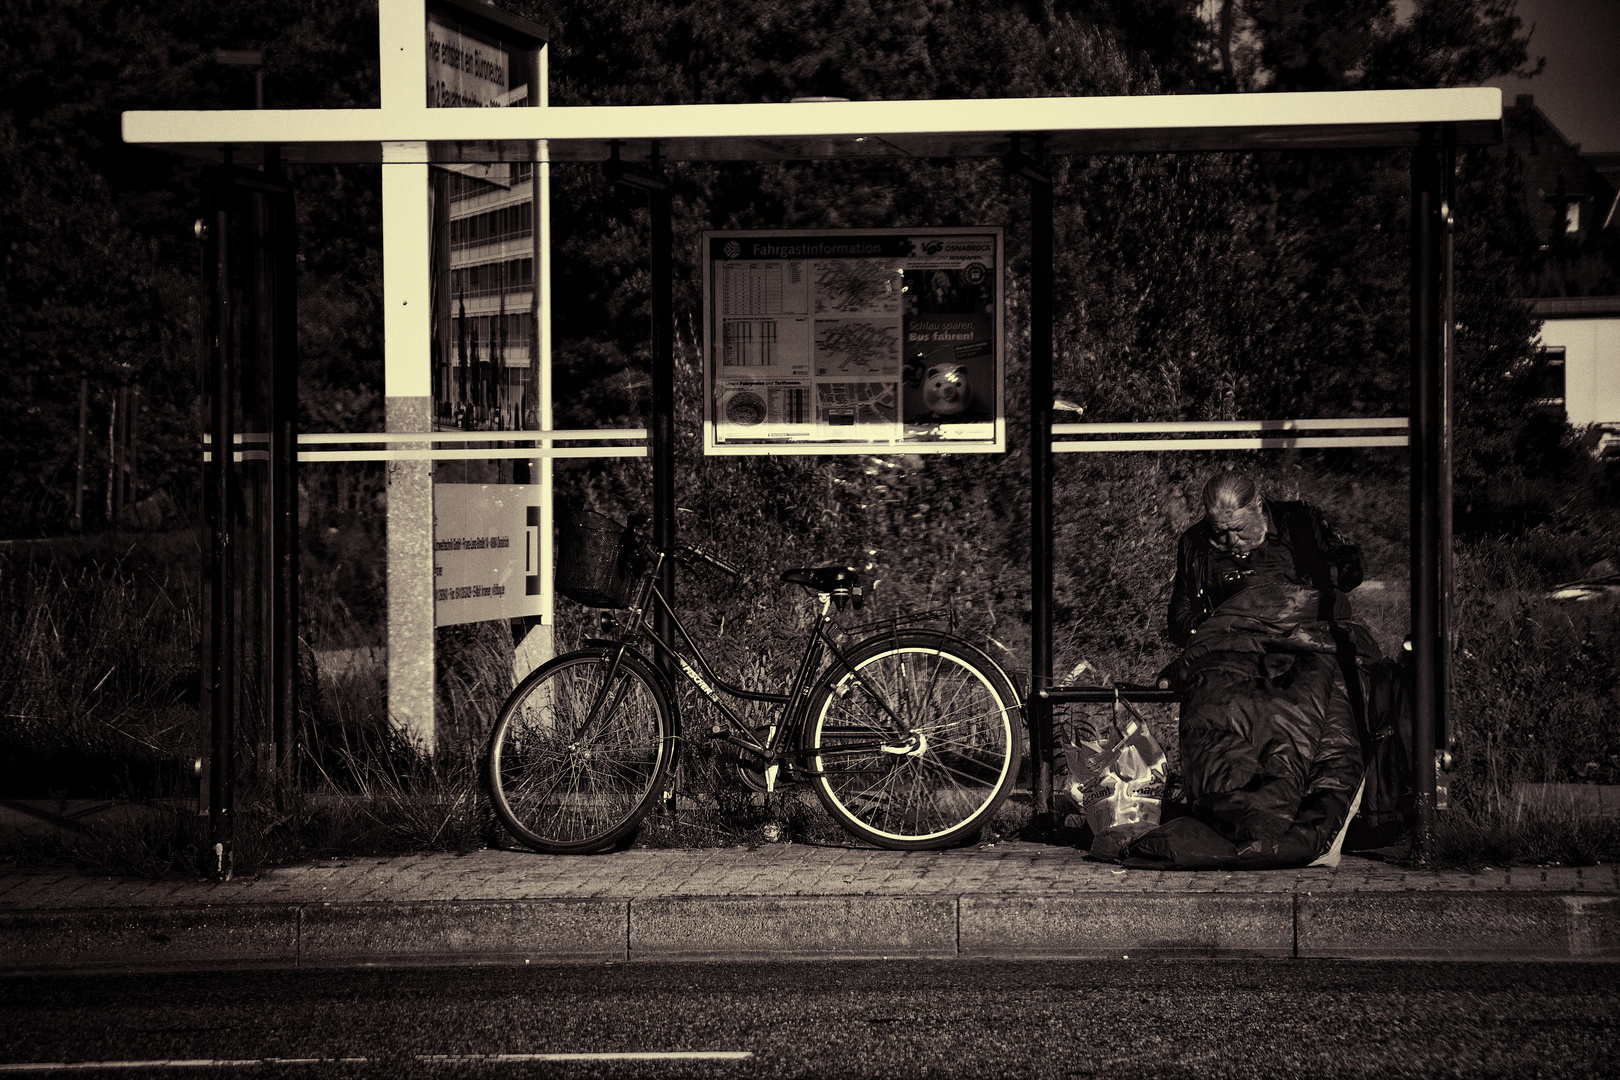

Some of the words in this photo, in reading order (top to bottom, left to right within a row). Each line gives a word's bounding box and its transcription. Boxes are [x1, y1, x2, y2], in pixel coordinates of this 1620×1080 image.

[753, 242, 882, 259] Fahrgastinformation
[945, 244, 992, 252] OSNABRÜCK
[909, 320, 940, 331] Schlau
[942, 321, 976, 332] sparen,
[908, 332, 930, 341] Bus
[932, 331, 975, 342] fahren!
[683, 665, 713, 696] FISCHER
